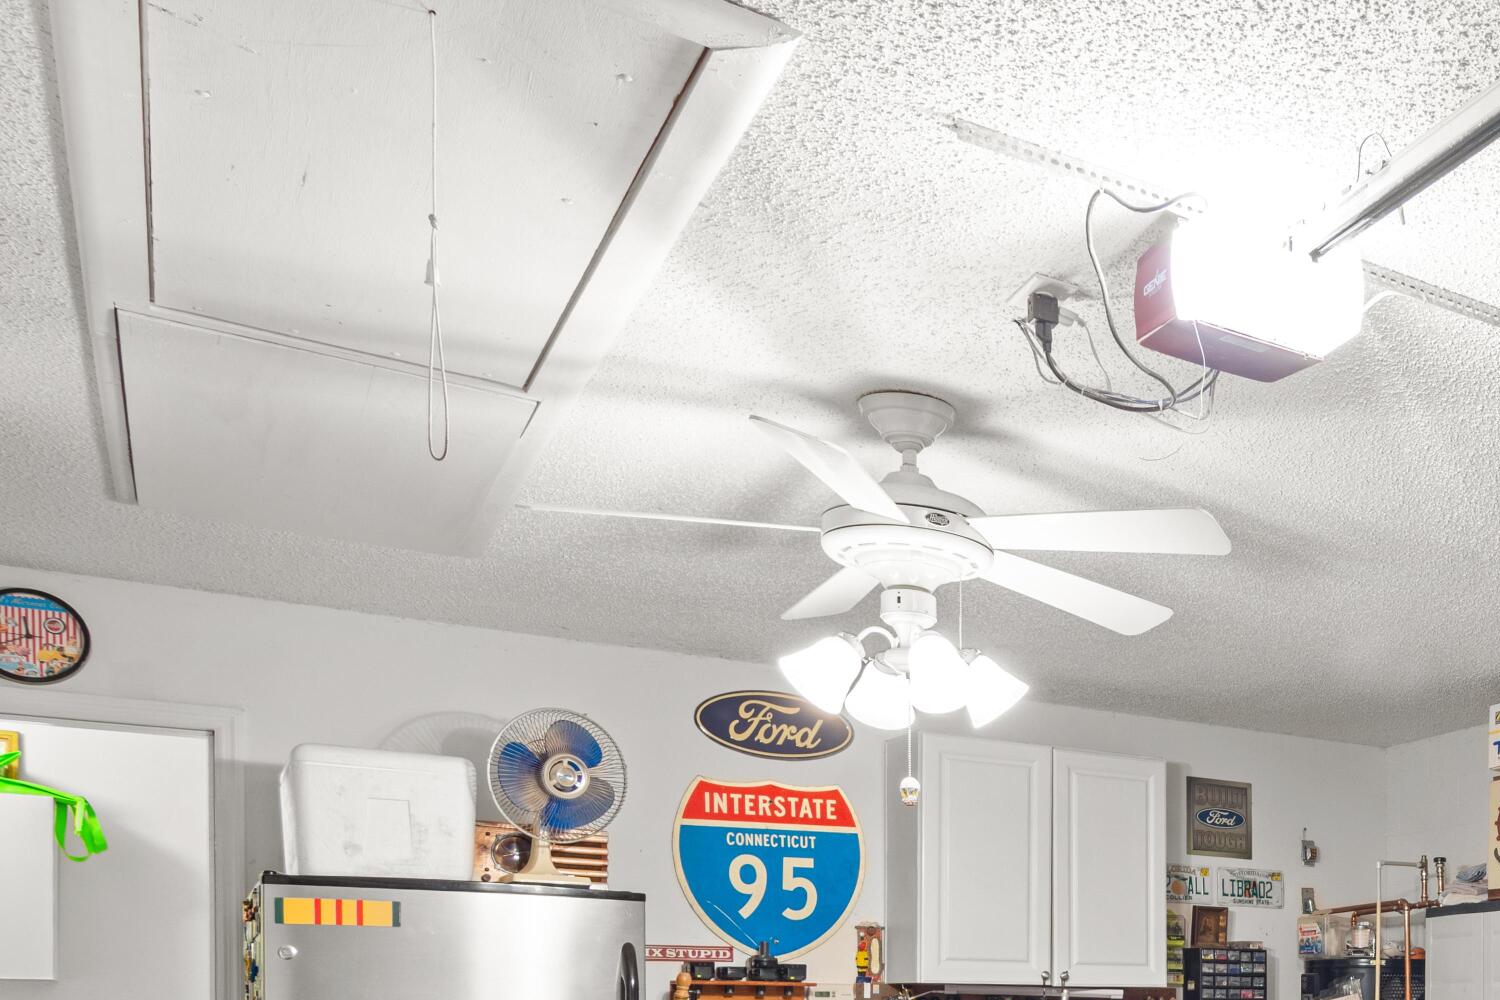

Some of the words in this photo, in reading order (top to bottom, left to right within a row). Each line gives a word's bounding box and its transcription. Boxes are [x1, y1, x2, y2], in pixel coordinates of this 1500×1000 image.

[1143, 269, 1167, 296] GENIE
[729, 699, 823, 749] Ford
[703, 791, 838, 821] INTERSTATE
[1206, 809, 1237, 827] Ford
[726, 832, 817, 850] CONNECTICUT
[1194, 830, 1247, 850] TOUGH
[728, 853, 818, 922] 95
[1187, 876, 1209, 896] ALL
[645, 948, 664, 958] IX
[666, 948, 731, 959] STUPID
